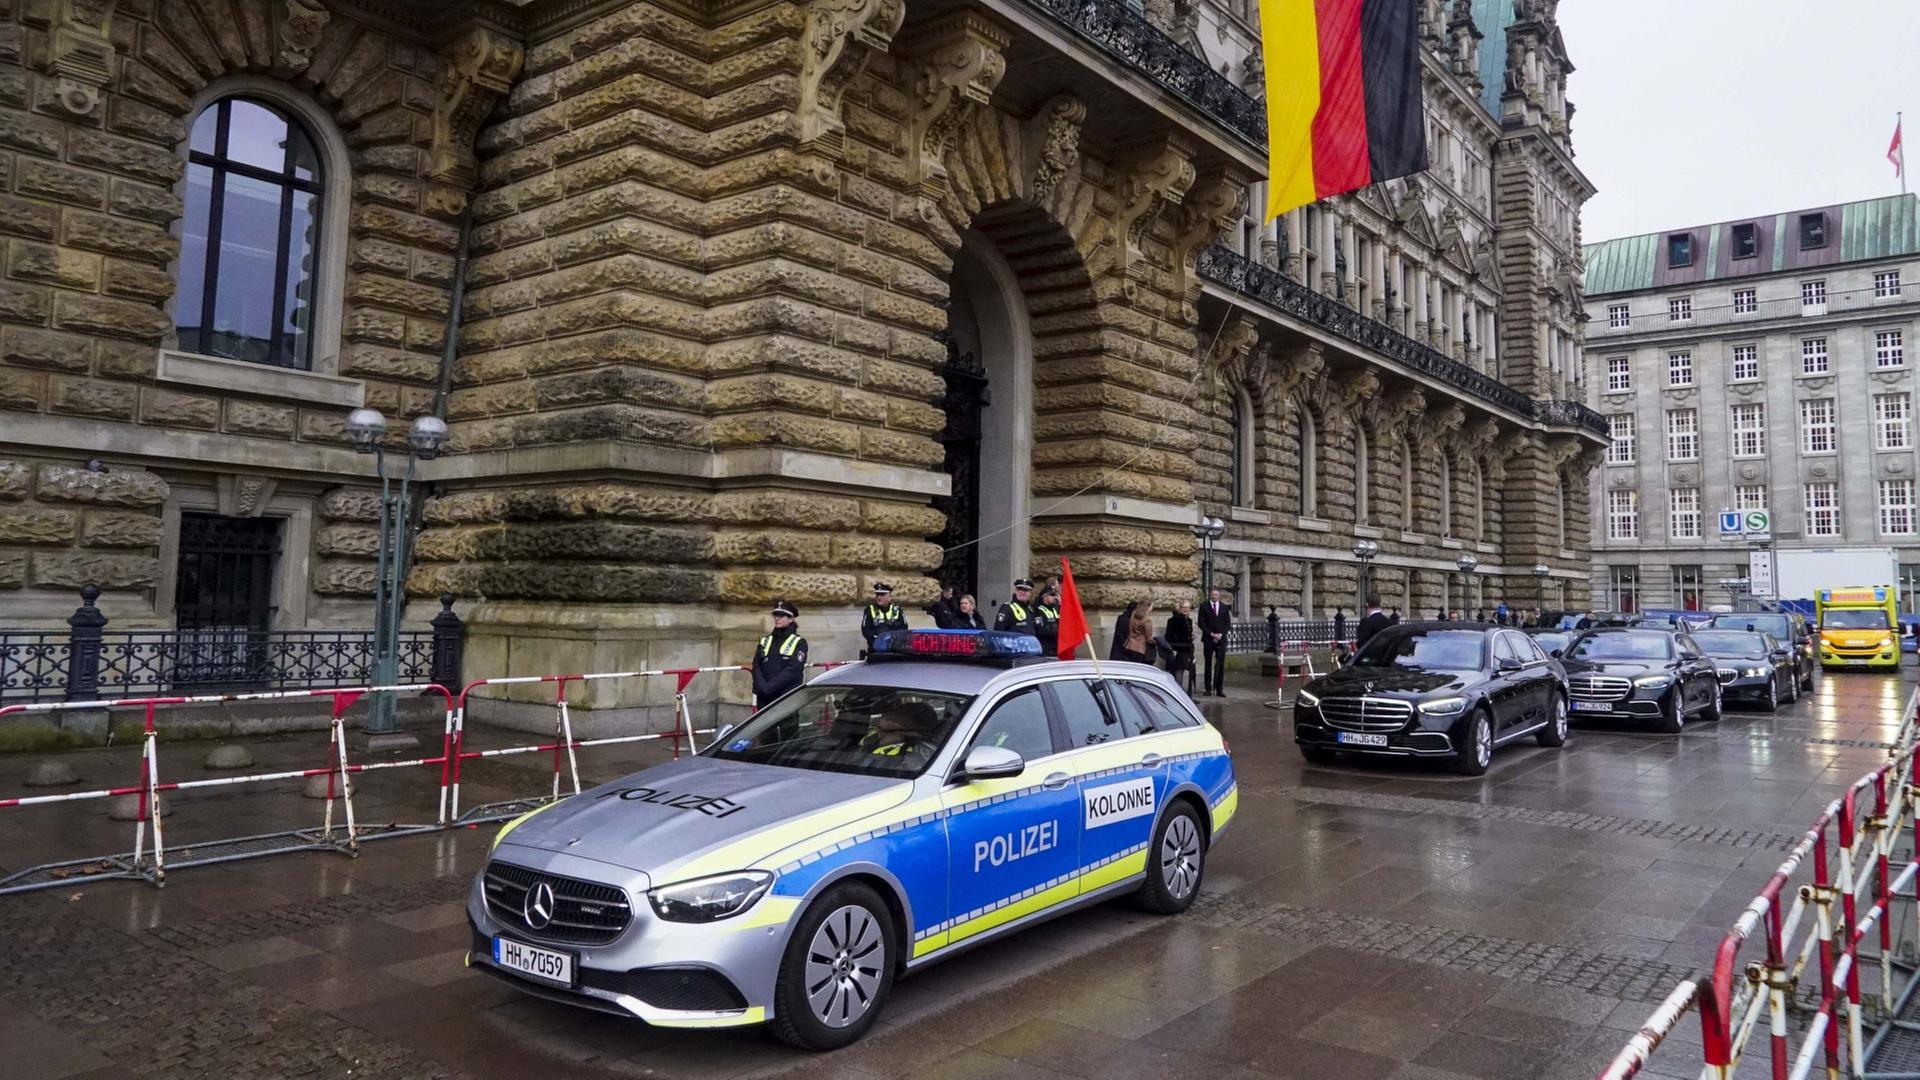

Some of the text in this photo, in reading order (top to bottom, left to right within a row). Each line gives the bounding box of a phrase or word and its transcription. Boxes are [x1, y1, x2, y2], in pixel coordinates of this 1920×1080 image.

[1722, 512, 1767, 531] U S
[1370, 736, 1386, 745] 429
[1088, 786, 1153, 820] KOLONNE
[973, 819, 1059, 873] POLIZEI
[505, 942, 564, 977] HH 7059
